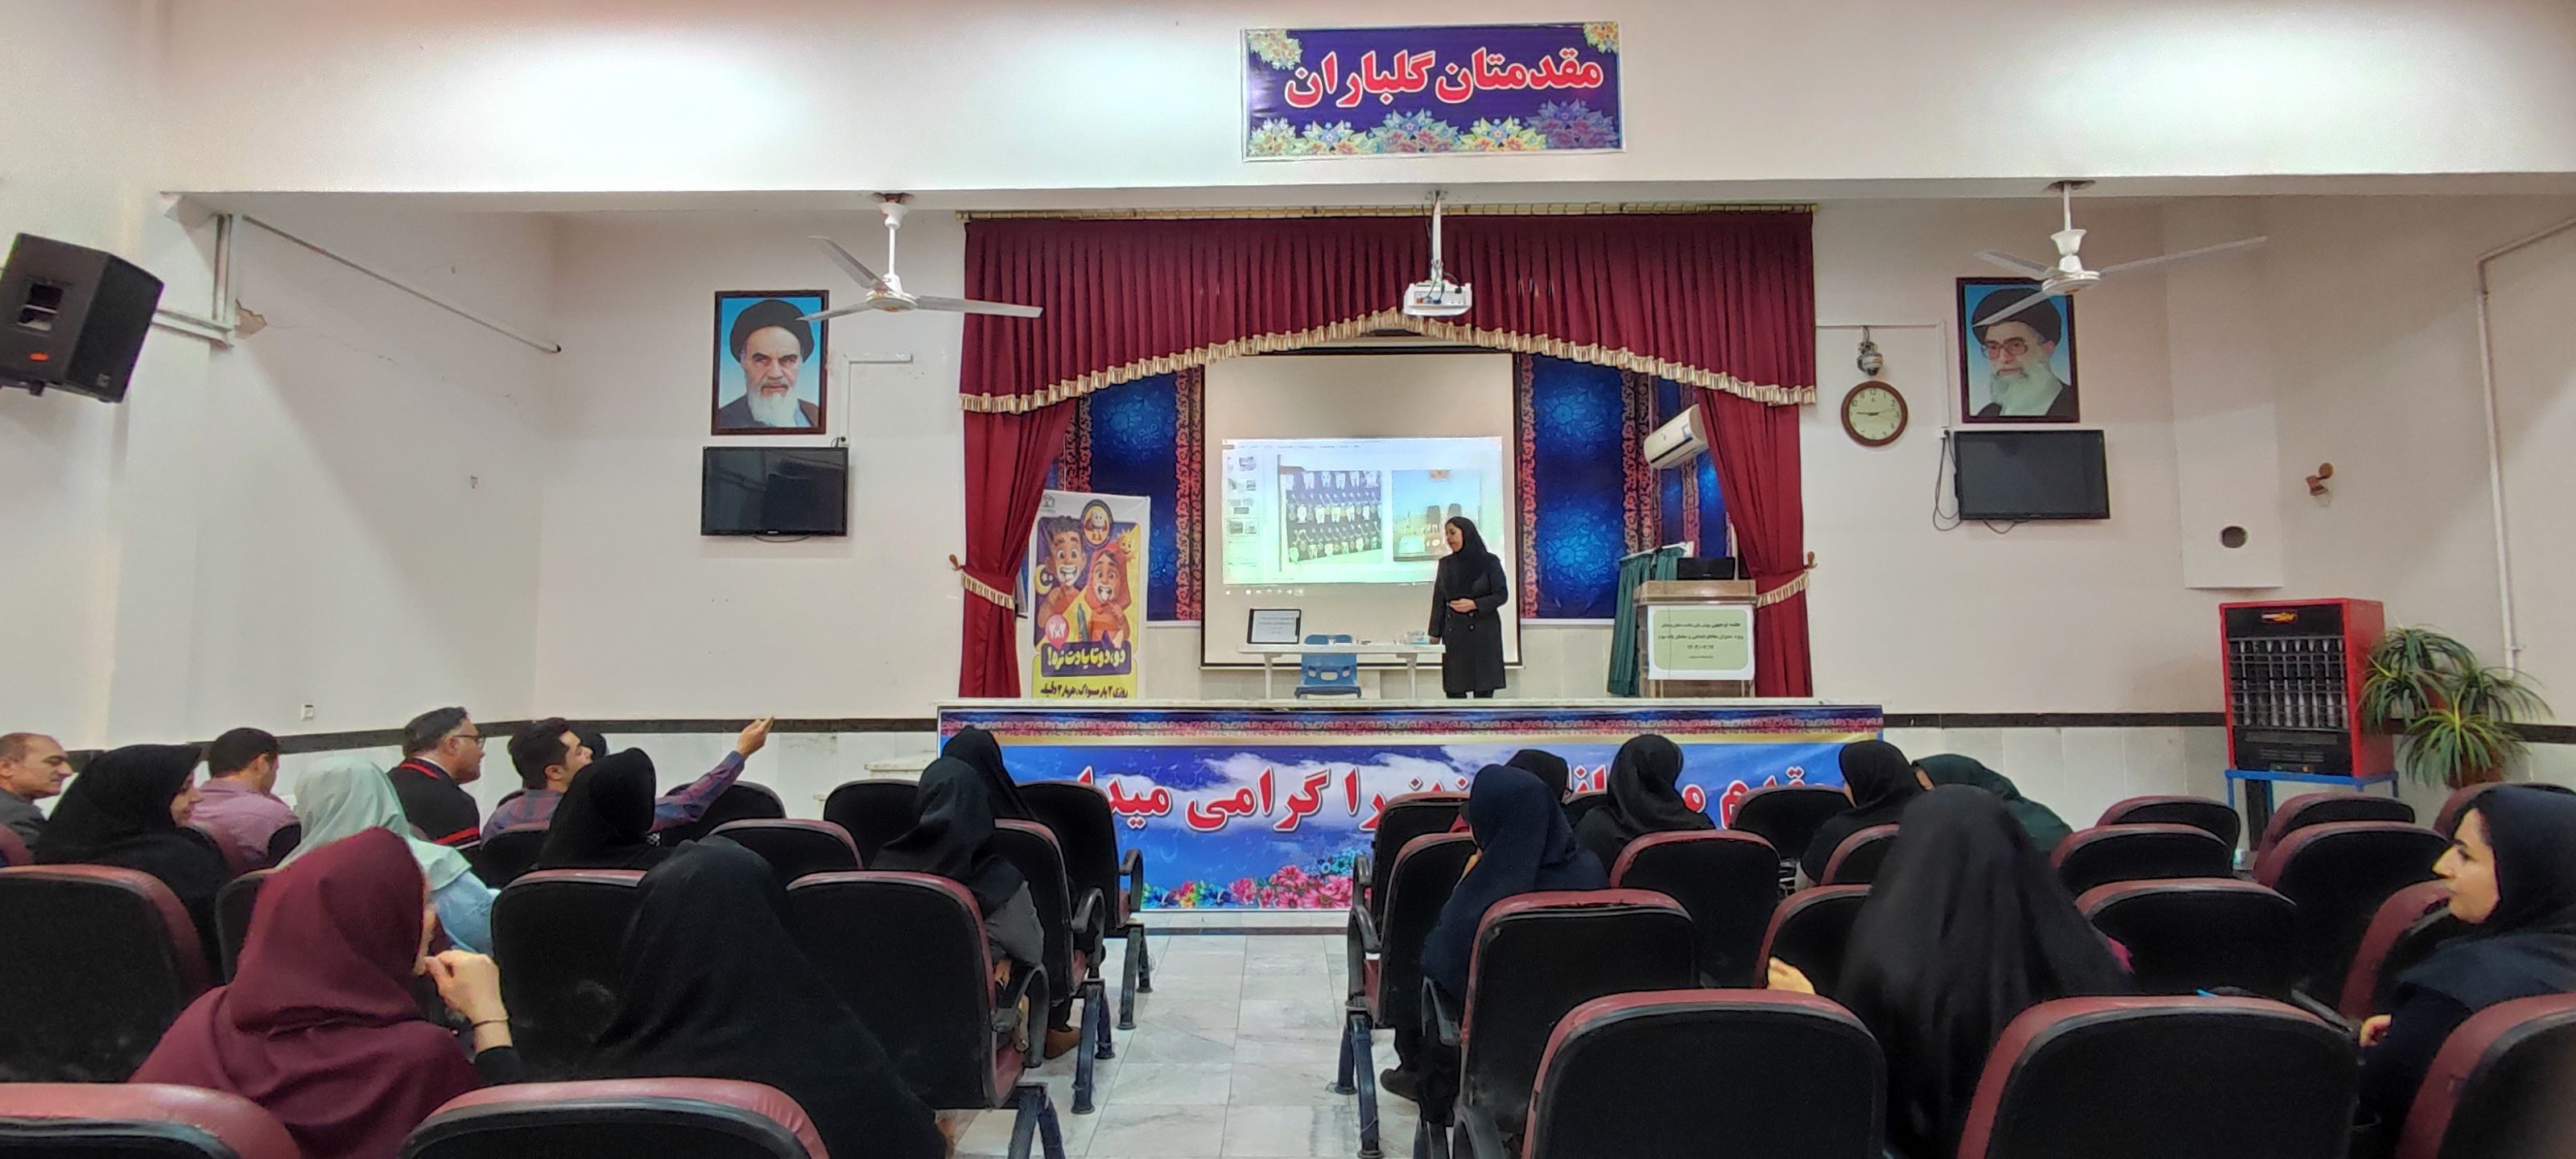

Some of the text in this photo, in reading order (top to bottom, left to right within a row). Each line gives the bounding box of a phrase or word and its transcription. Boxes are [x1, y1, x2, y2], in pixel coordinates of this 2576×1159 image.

[1284, 47, 1604, 108] مقدمتان گلباران
[1185, 765, 1331, 832] گرامی
